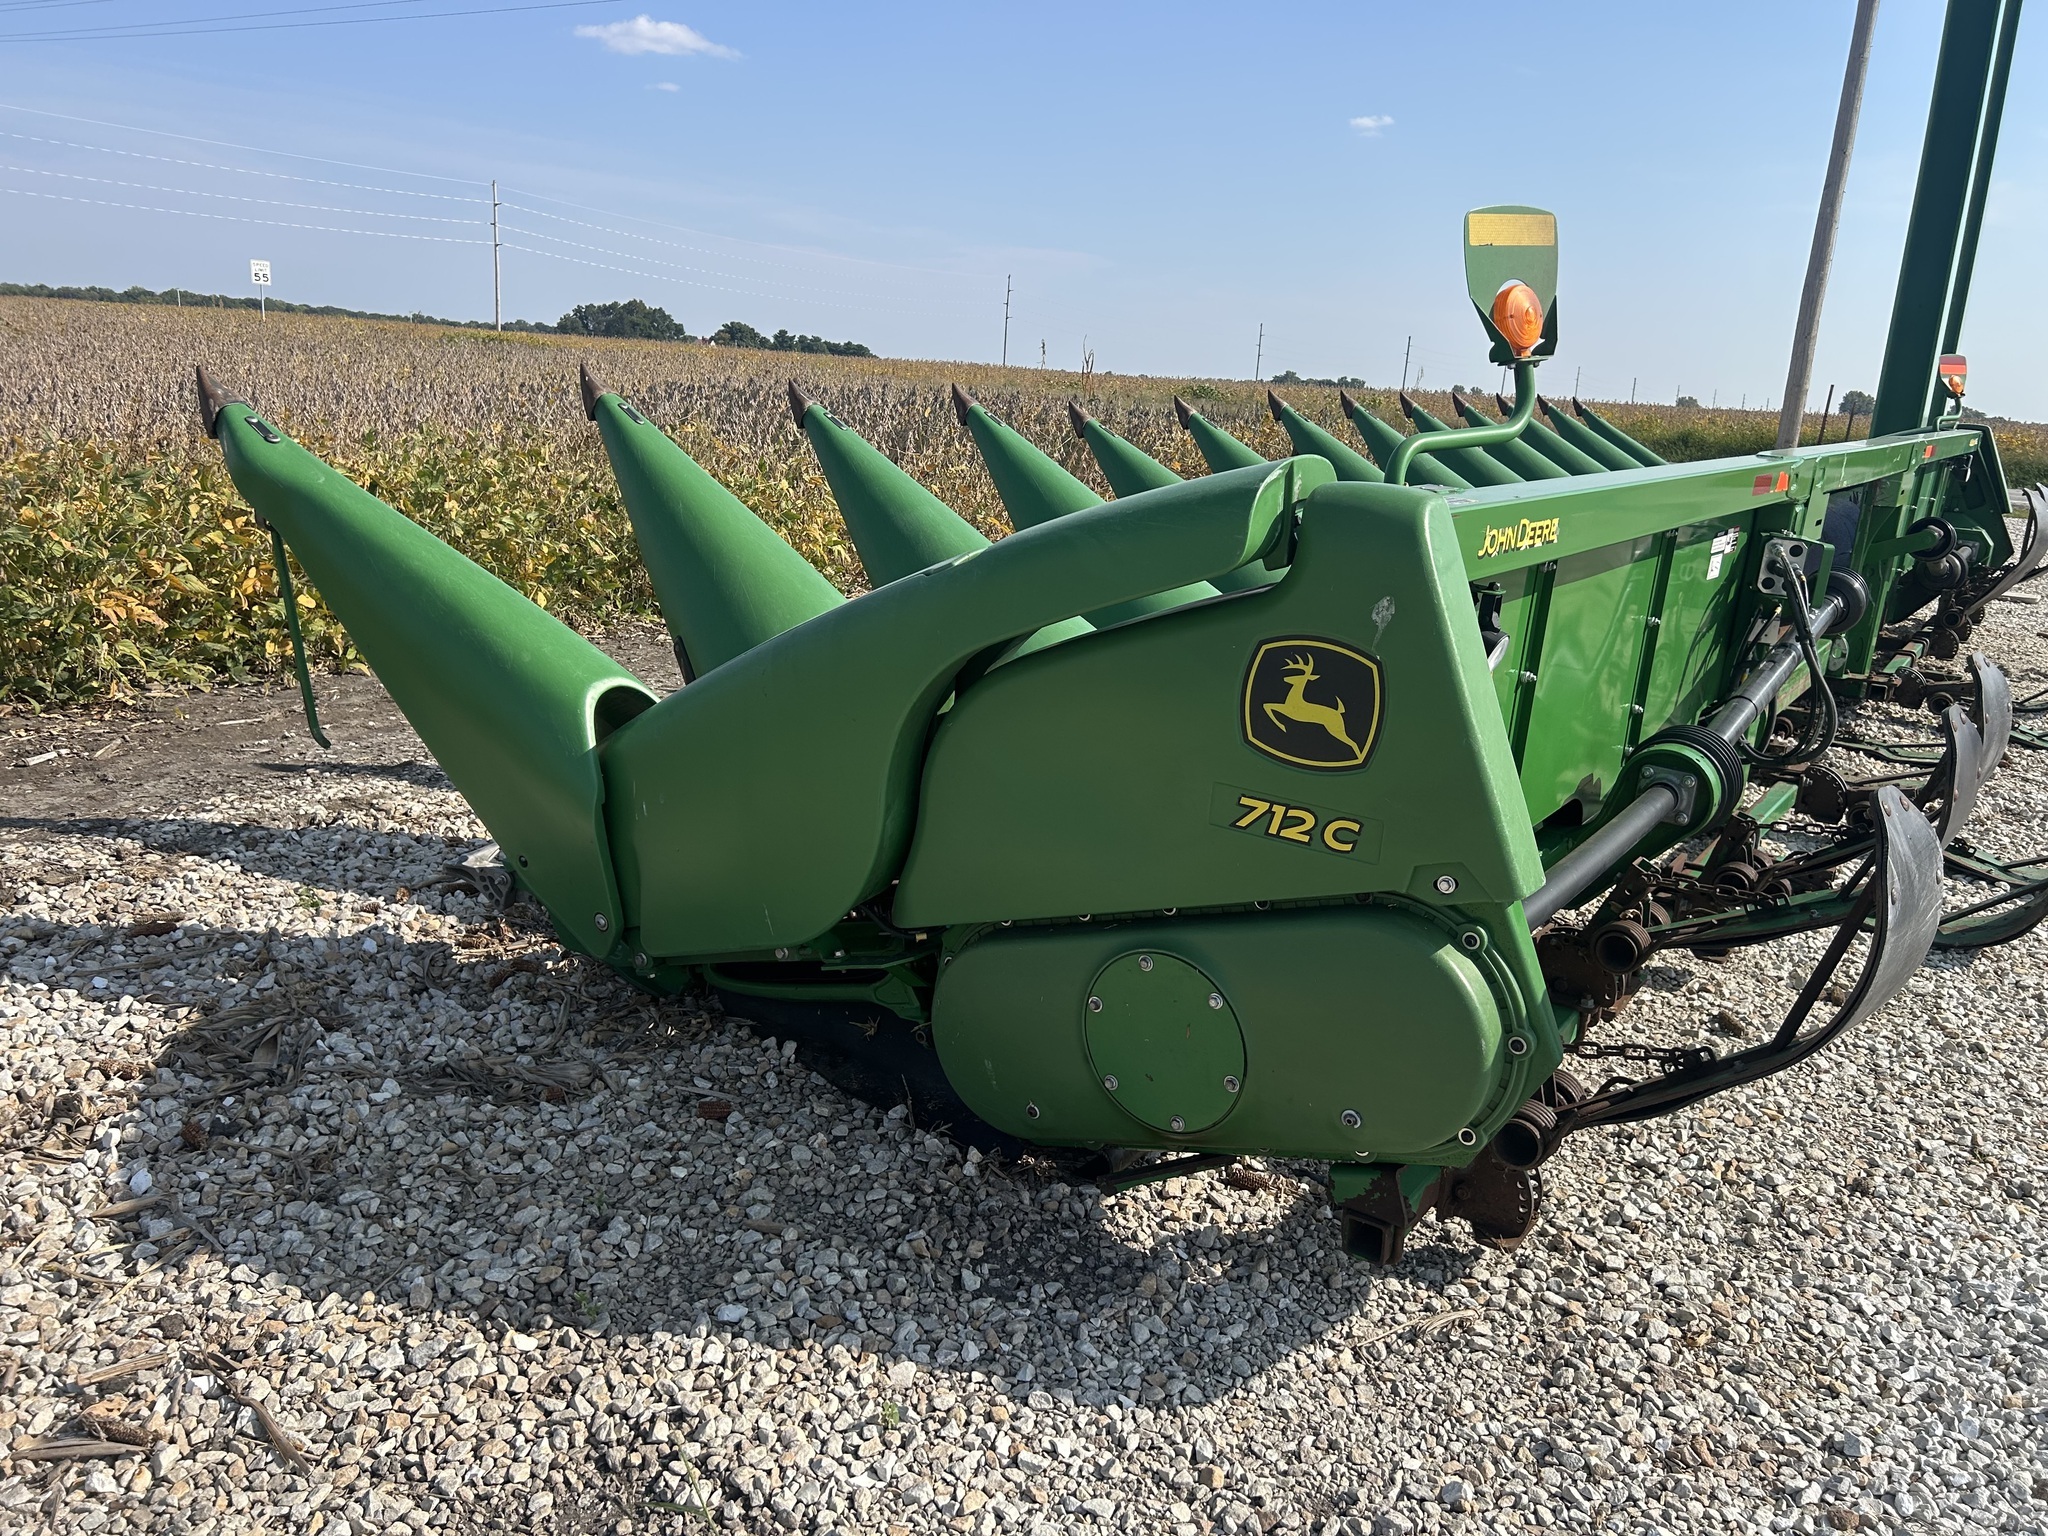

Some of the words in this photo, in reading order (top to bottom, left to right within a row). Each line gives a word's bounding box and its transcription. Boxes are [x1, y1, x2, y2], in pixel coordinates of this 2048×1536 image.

[254, 272, 269, 282] 55
[1477, 525, 1518, 559] JOHN
[1517, 518, 1560, 550] DEERE
[1231, 795, 1317, 845] 712
[1321, 817, 1364, 853] C
